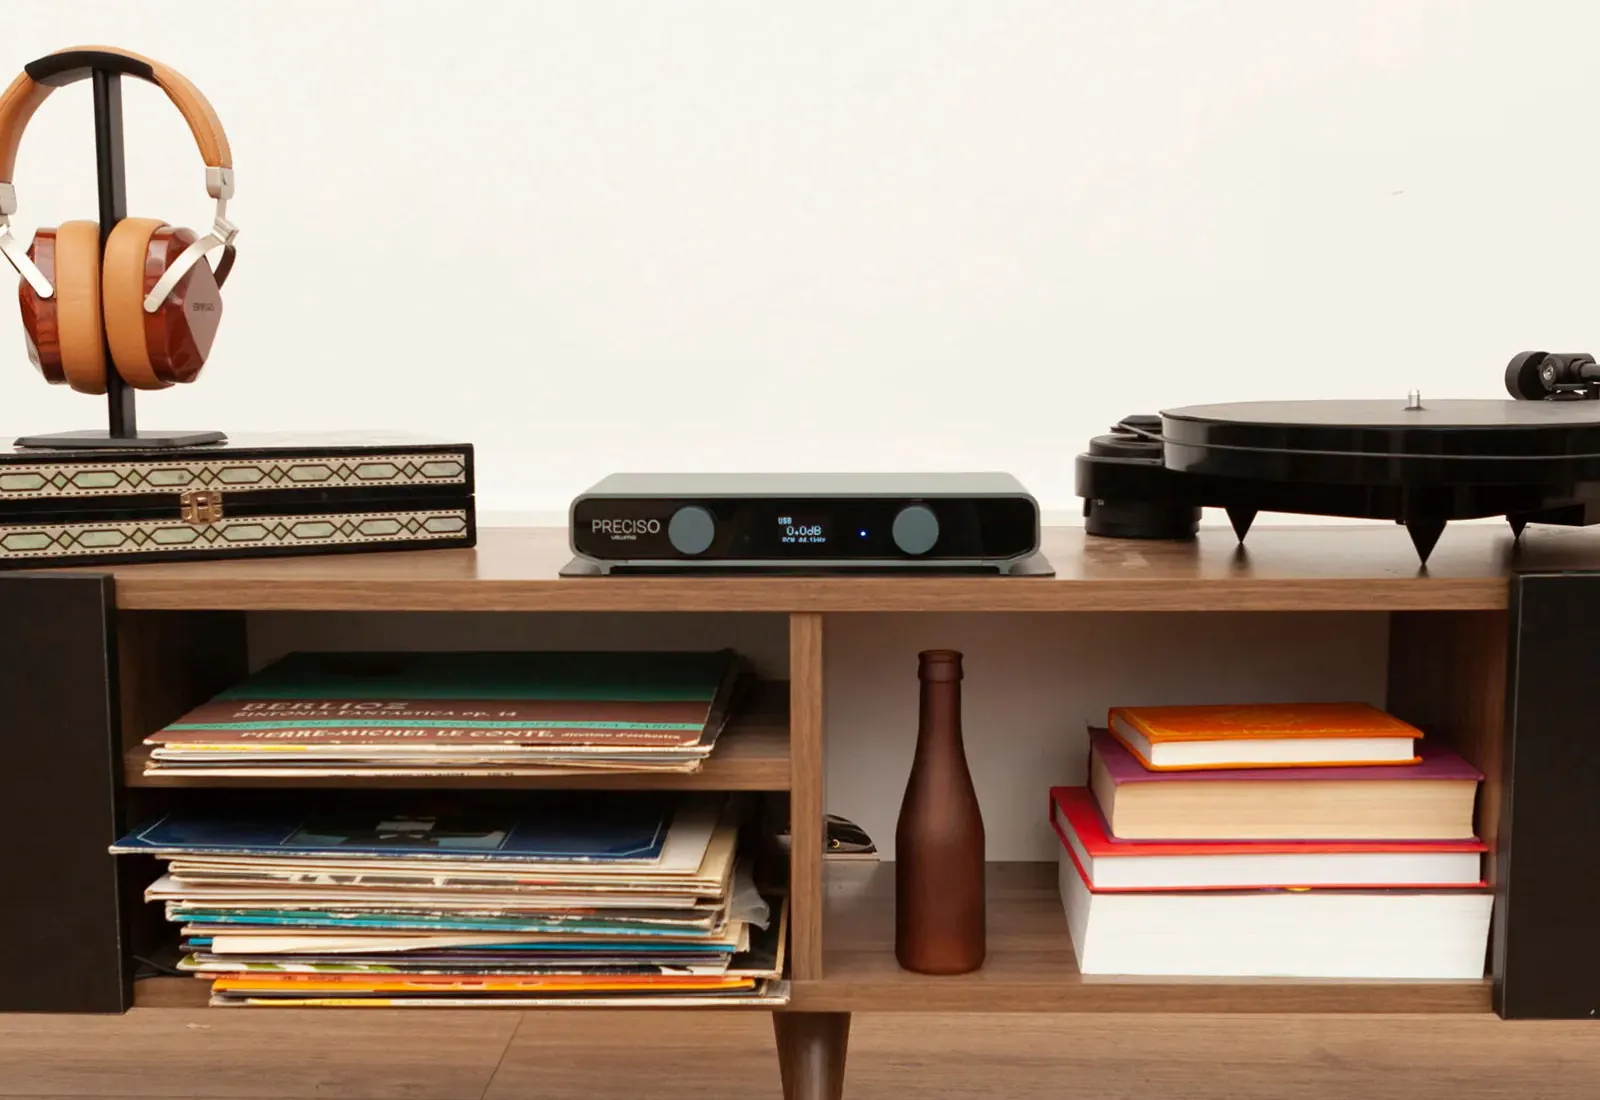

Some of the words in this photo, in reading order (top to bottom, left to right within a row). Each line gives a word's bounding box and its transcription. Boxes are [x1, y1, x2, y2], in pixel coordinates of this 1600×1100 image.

[591, 519, 660, 533] PRECISO
[786, 526, 821, 535] 0.0dB
[242, 702, 408, 710] BERLIOZ
[240, 730, 428, 738] PIERRE-MICHEL
